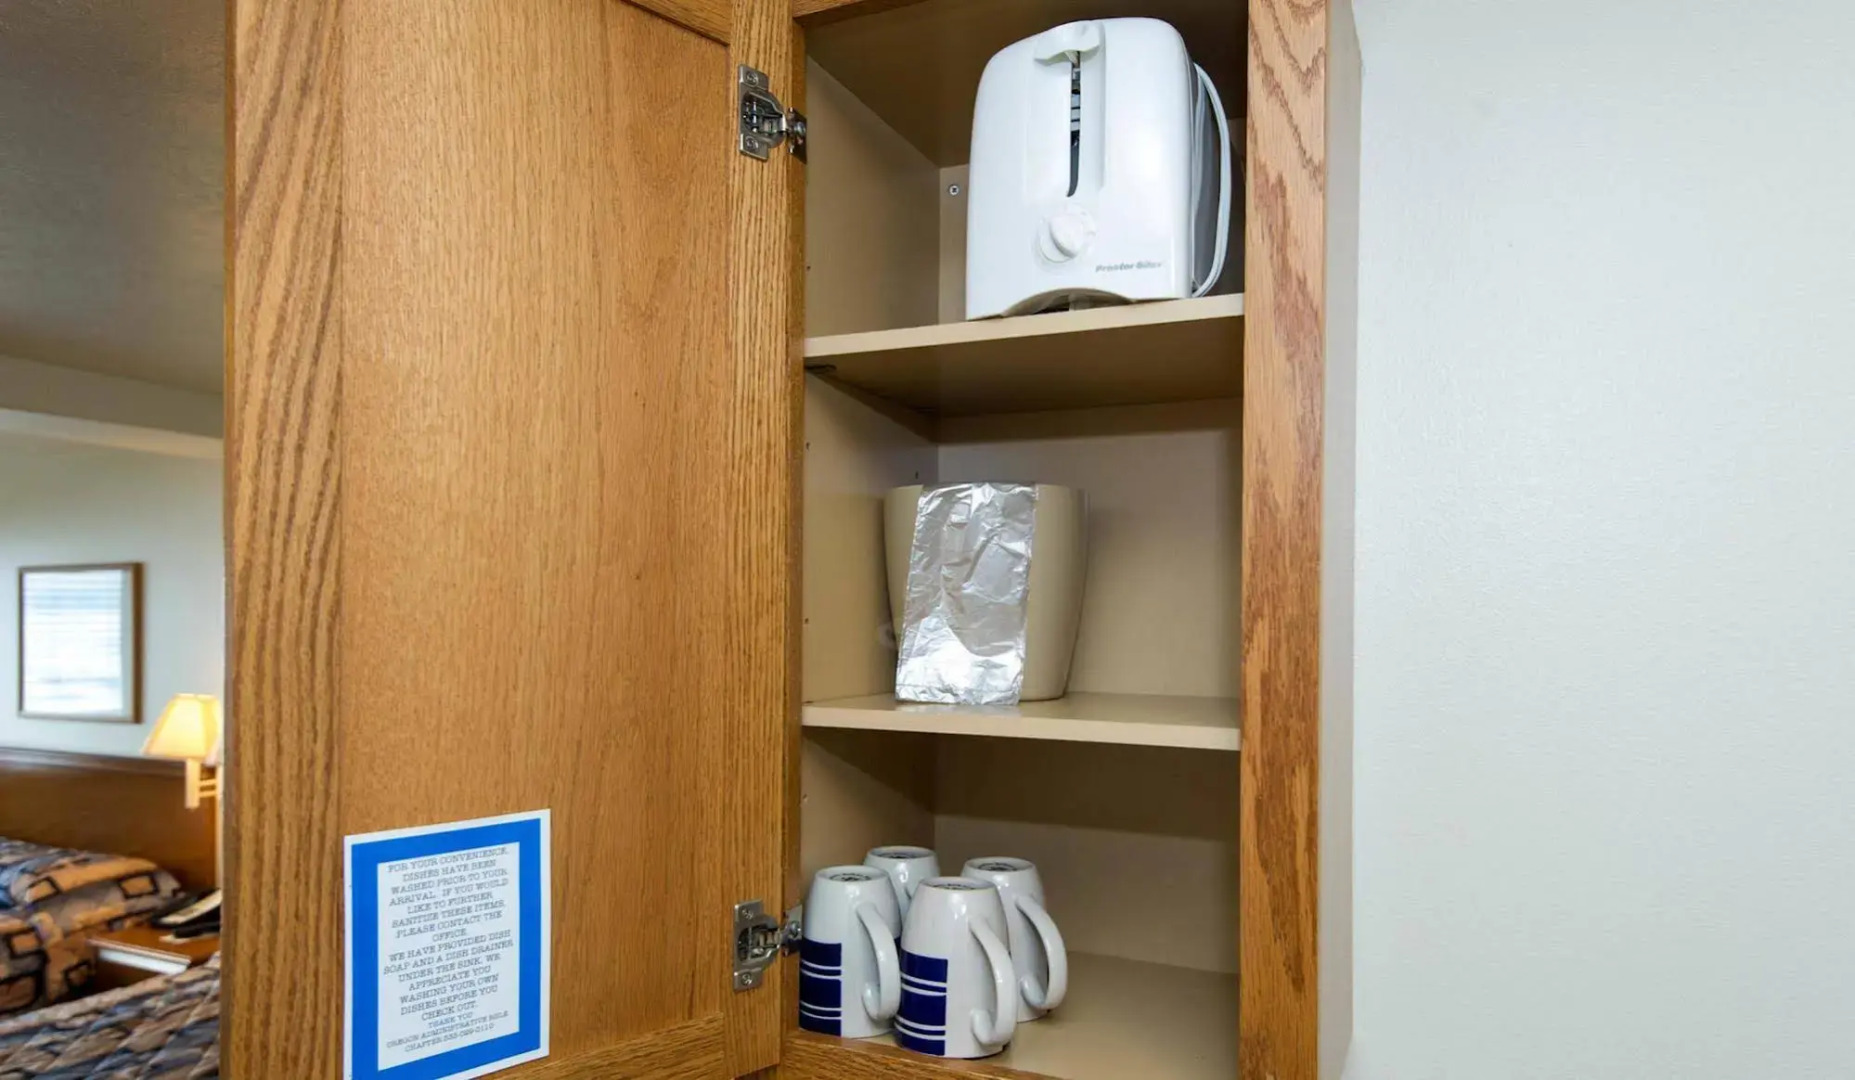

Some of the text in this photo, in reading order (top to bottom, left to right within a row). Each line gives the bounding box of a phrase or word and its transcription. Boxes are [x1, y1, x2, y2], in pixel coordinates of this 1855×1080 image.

[403, 859, 496, 882] DISHES HAVE BEEN
[411, 859, 438, 869] YOUR
[391, 868, 508, 895] WASHED PRIOR TO YOUR
[442, 888, 453, 896] IF
[455, 884, 474, 895] YOU
[478, 878, 509, 891] WOULD
[408, 892, 493, 914] LIKE TO FURTHER
[392, 912, 438, 929] SANITIZE
[442, 906, 472, 918] THESE
[396, 910, 502, 939] PLEASE CONTACT THE
[384, 962, 410, 975] SOAP
[412, 957, 434, 969] AND
[446, 949, 469, 961] DISH
[471, 940, 514, 956] DRAINER
[389, 930, 511, 962] WE HAVE PROVIDED DISH
[399, 968, 434, 982] UNDER
[436, 962, 456, 972] THE
[486, 953, 501, 962] WE
[409, 965, 491, 991] APPRECIATE YOU
[400, 974, 499, 1004] WASHING YOUR OWN
[401, 985, 498, 1015] DISHES BEFORE YOU
[422, 1006, 455, 1021] CHECK
[429, 1016, 456, 1028] THANK
